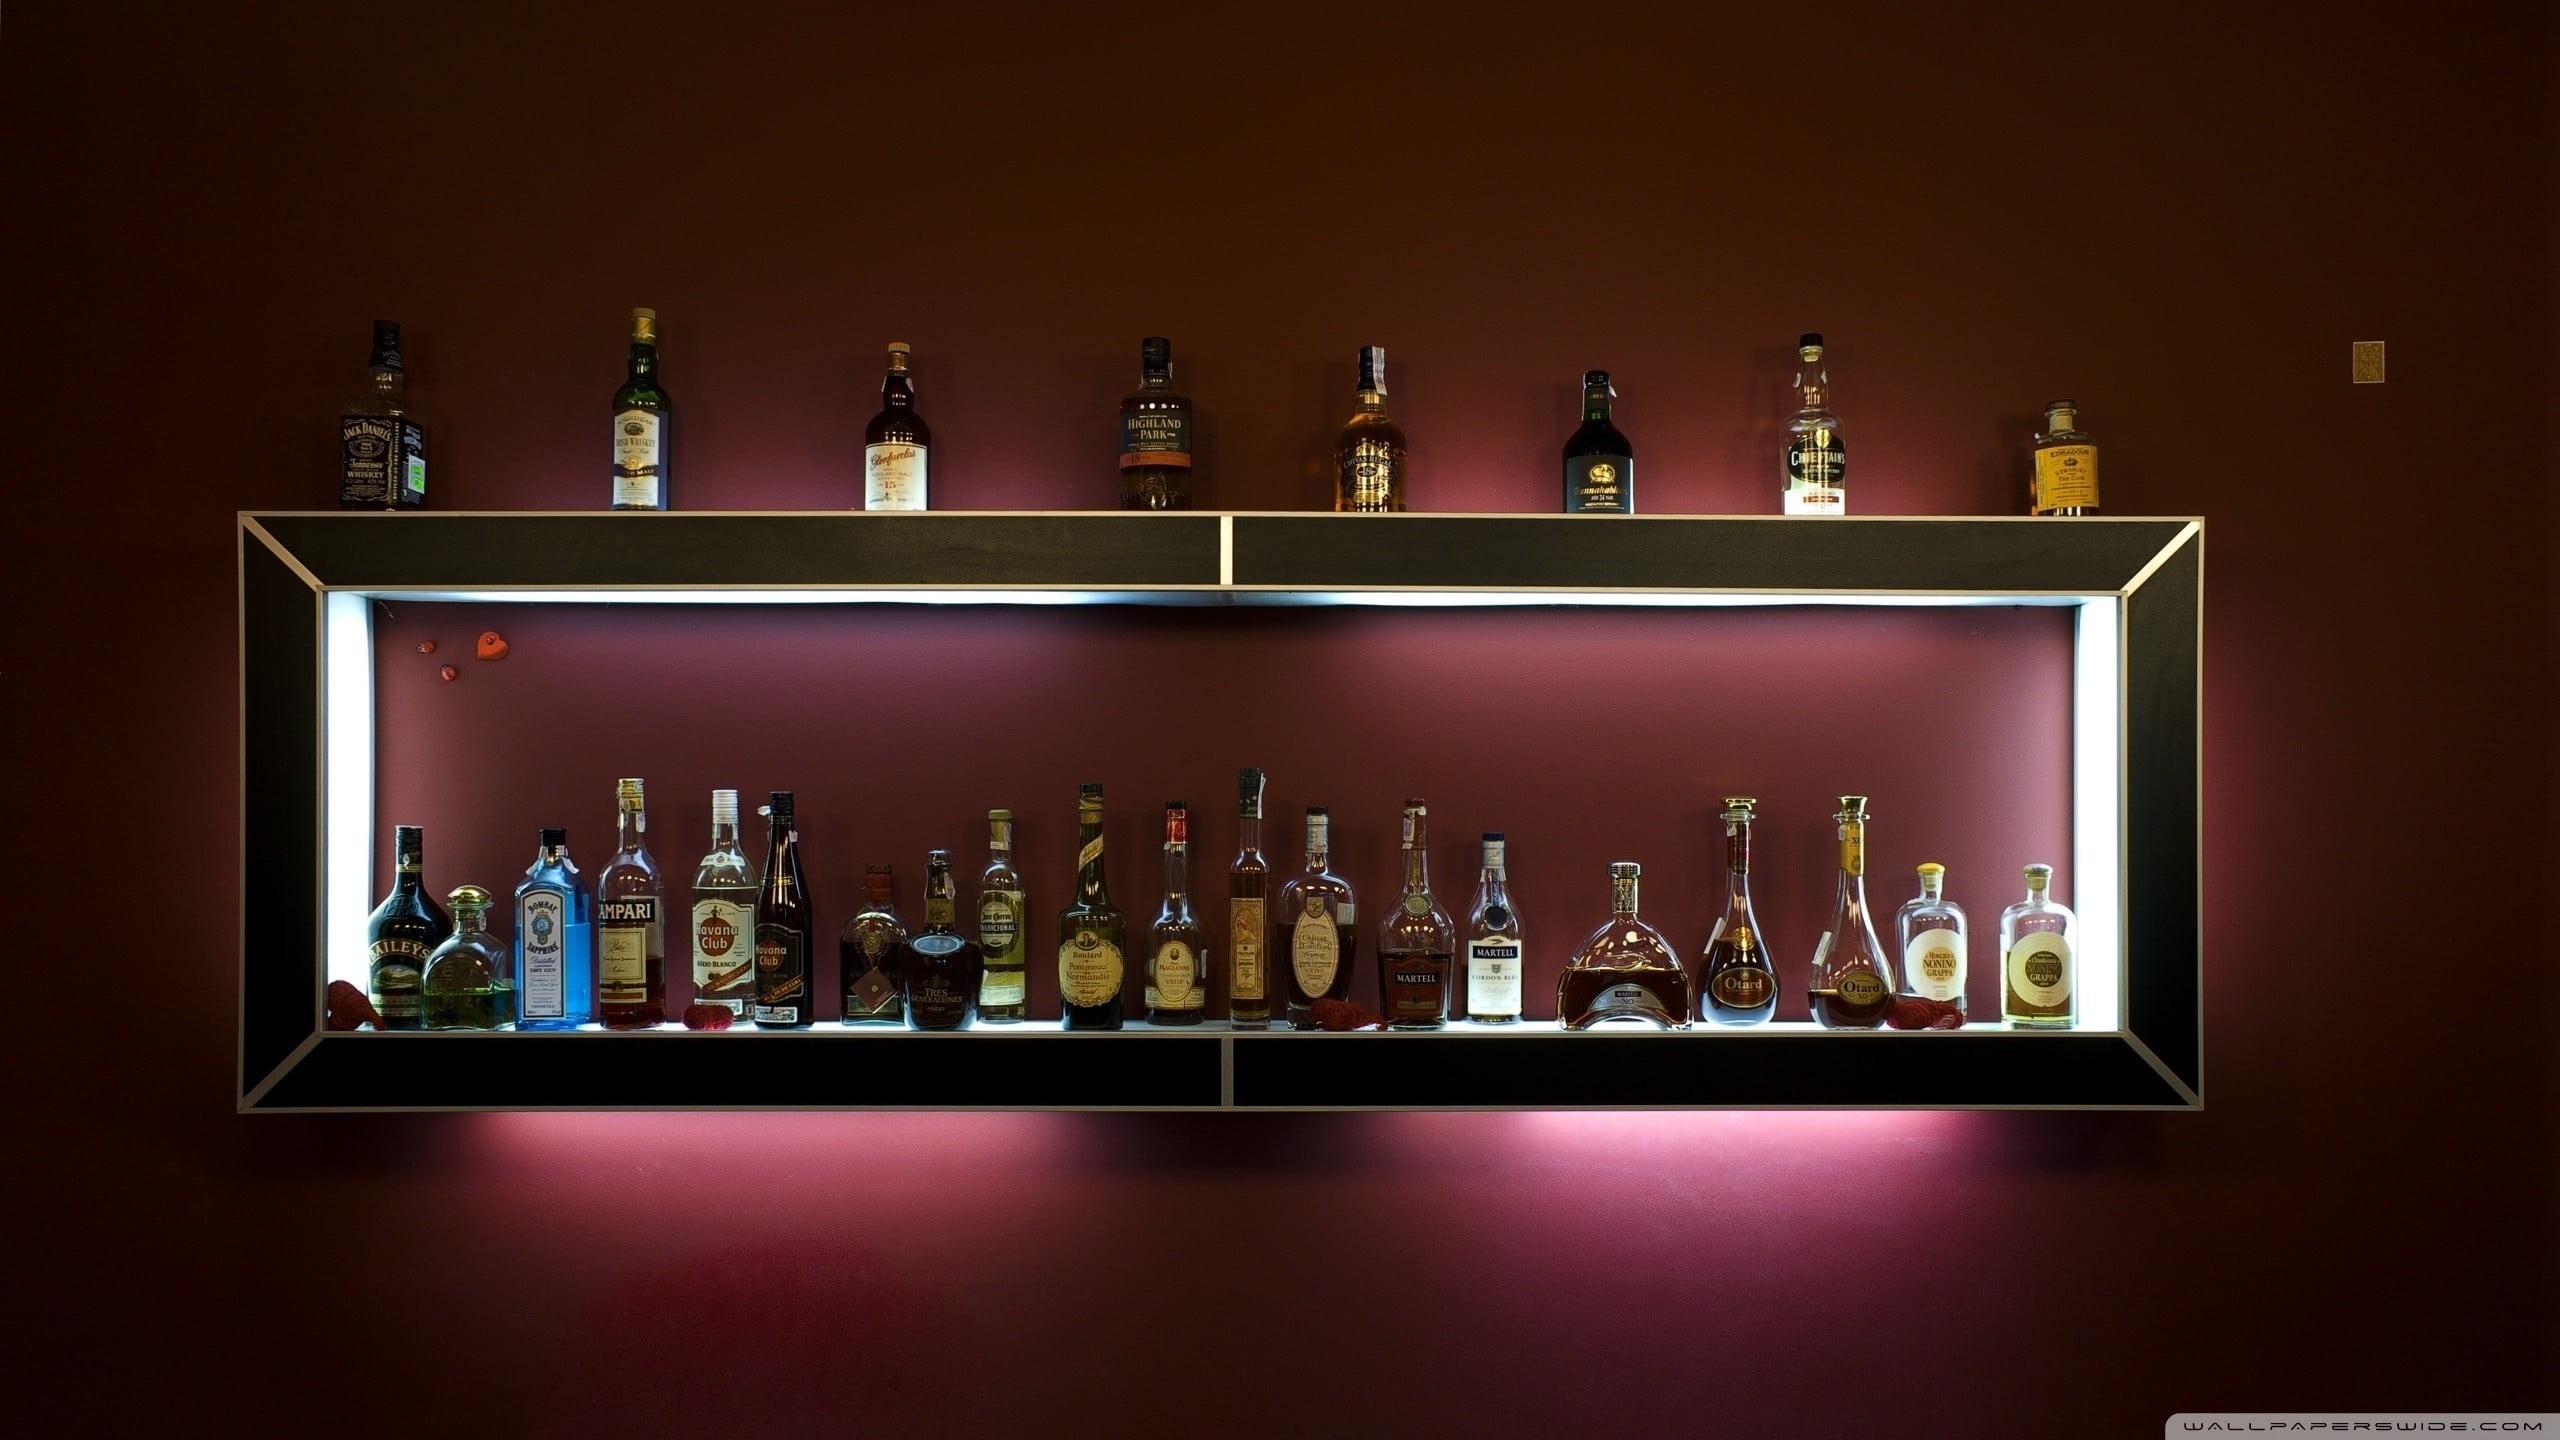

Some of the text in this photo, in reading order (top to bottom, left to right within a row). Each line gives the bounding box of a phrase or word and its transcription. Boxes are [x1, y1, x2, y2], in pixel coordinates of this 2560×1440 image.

[1128, 418, 1182, 430] HIGHLAND
[343, 425, 362, 440] JACK
[1140, 429, 1168, 440] PARK
[349, 459, 384, 469] Tennessee
[870, 448, 916, 471] Glenfarclas
[1343, 455, 1392, 469] CHIVAS REGAL
[884, 481, 897, 489] 15
[528, 900, 558, 914] BOMBAY
[598, 903, 651, 919] AMPARI
[696, 922, 739, 936] Havana
[527, 942, 560, 955] SAPPHIRE
[702, 937, 728, 949] Club
[369, 940, 430, 961] BAILEYS
[1072, 951, 1102, 959] Boulard
[1477, 949, 1515, 957] MARTELL
[759, 955, 779, 966] Club
[1923, 959, 1956, 969] NONINO
[1066, 972, 1110, 981] Normandie
[1397, 974, 1436, 983] MARTELL
[1927, 969, 1954, 977] GRAPPA
[2030, 973, 2058, 981] GRAPPA
[1724, 977, 1763, 990] Otard
[1844, 981, 1880, 993] Otard
[924, 988, 948, 997] TRES
